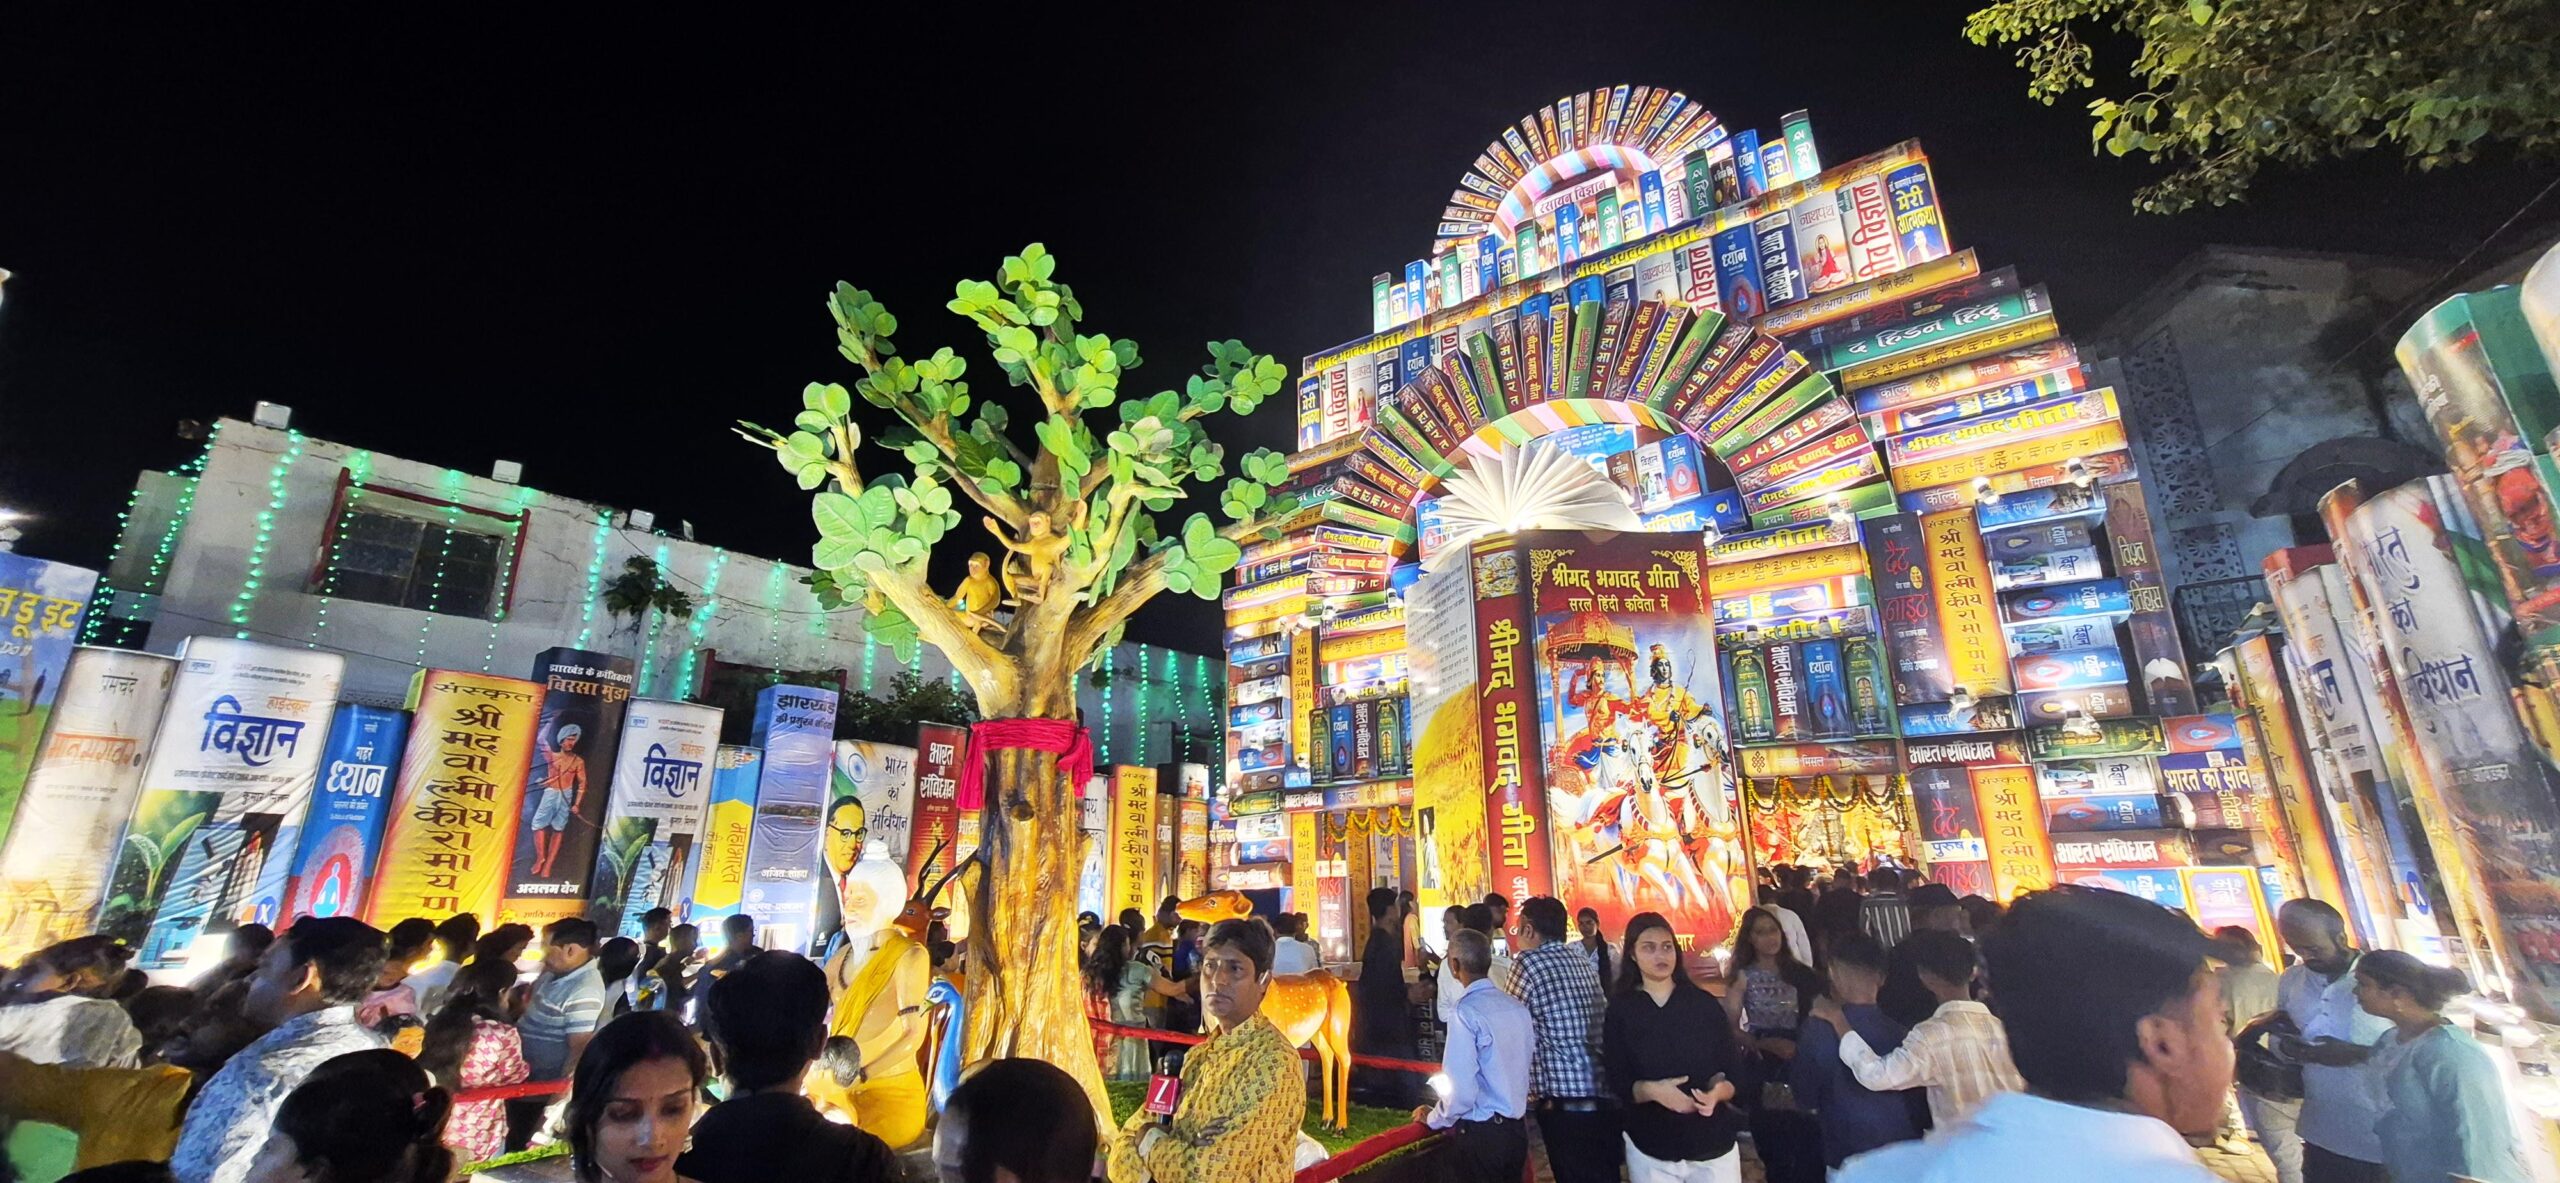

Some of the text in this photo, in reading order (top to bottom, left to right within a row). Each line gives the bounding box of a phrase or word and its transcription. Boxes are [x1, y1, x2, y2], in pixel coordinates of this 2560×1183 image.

[1895, 184, 1925, 212] मेरी
[1721, 247, 1748, 268] ध्यान
[1849, 302, 2008, 354] द हिडन हिंदू
[1592, 324, 1618, 391] महाभारत
[1749, 342, 1770, 362] गीता
[1674, 345, 1729, 411] महाभारत
[1737, 416, 1818, 467] महाभारत
[1832, 432, 1859, 450] गीता
[1762, 514, 1785, 526] प्रथम
[1763, 525, 1826, 549] गीता
[2117, 535, 2148, 567] विश्व
[1551, 562, 1594, 596] श्रीमद्
[1596, 569, 1646, 596] भगवद्
[1646, 563, 1680, 589] गीता
[11, 592, 42, 640] डू
[40, 597, 84, 633] इट
[1568, 593, 1671, 613] सरल हिंदी कविता में
[1483, 617, 1520, 698] श्रीमद्
[433, 681, 534, 704] संस्कृत
[547, 674, 631, 704] बिरसा मुंडा
[777, 694, 836, 715] झारखंड
[200, 694, 306, 767] विज्ञान
[929, 742, 954, 766] भारत
[1488, 700, 1521, 796] भगवद्
[1909, 739, 1996, 764] भारत संविधान
[326, 760, 389, 798] ध्यान
[643, 743, 703, 799] विज्ञान
[2165, 766, 2220, 791] भारत का
[920, 773, 956, 800] संविधान
[871, 804, 908, 832] संविधान
[1501, 800, 1536, 870] गीता
[1930, 840, 1966, 858] पुरुष
[2056, 837, 2159, 864] भारत संविधान
[516, 883, 560, 895] असलम
